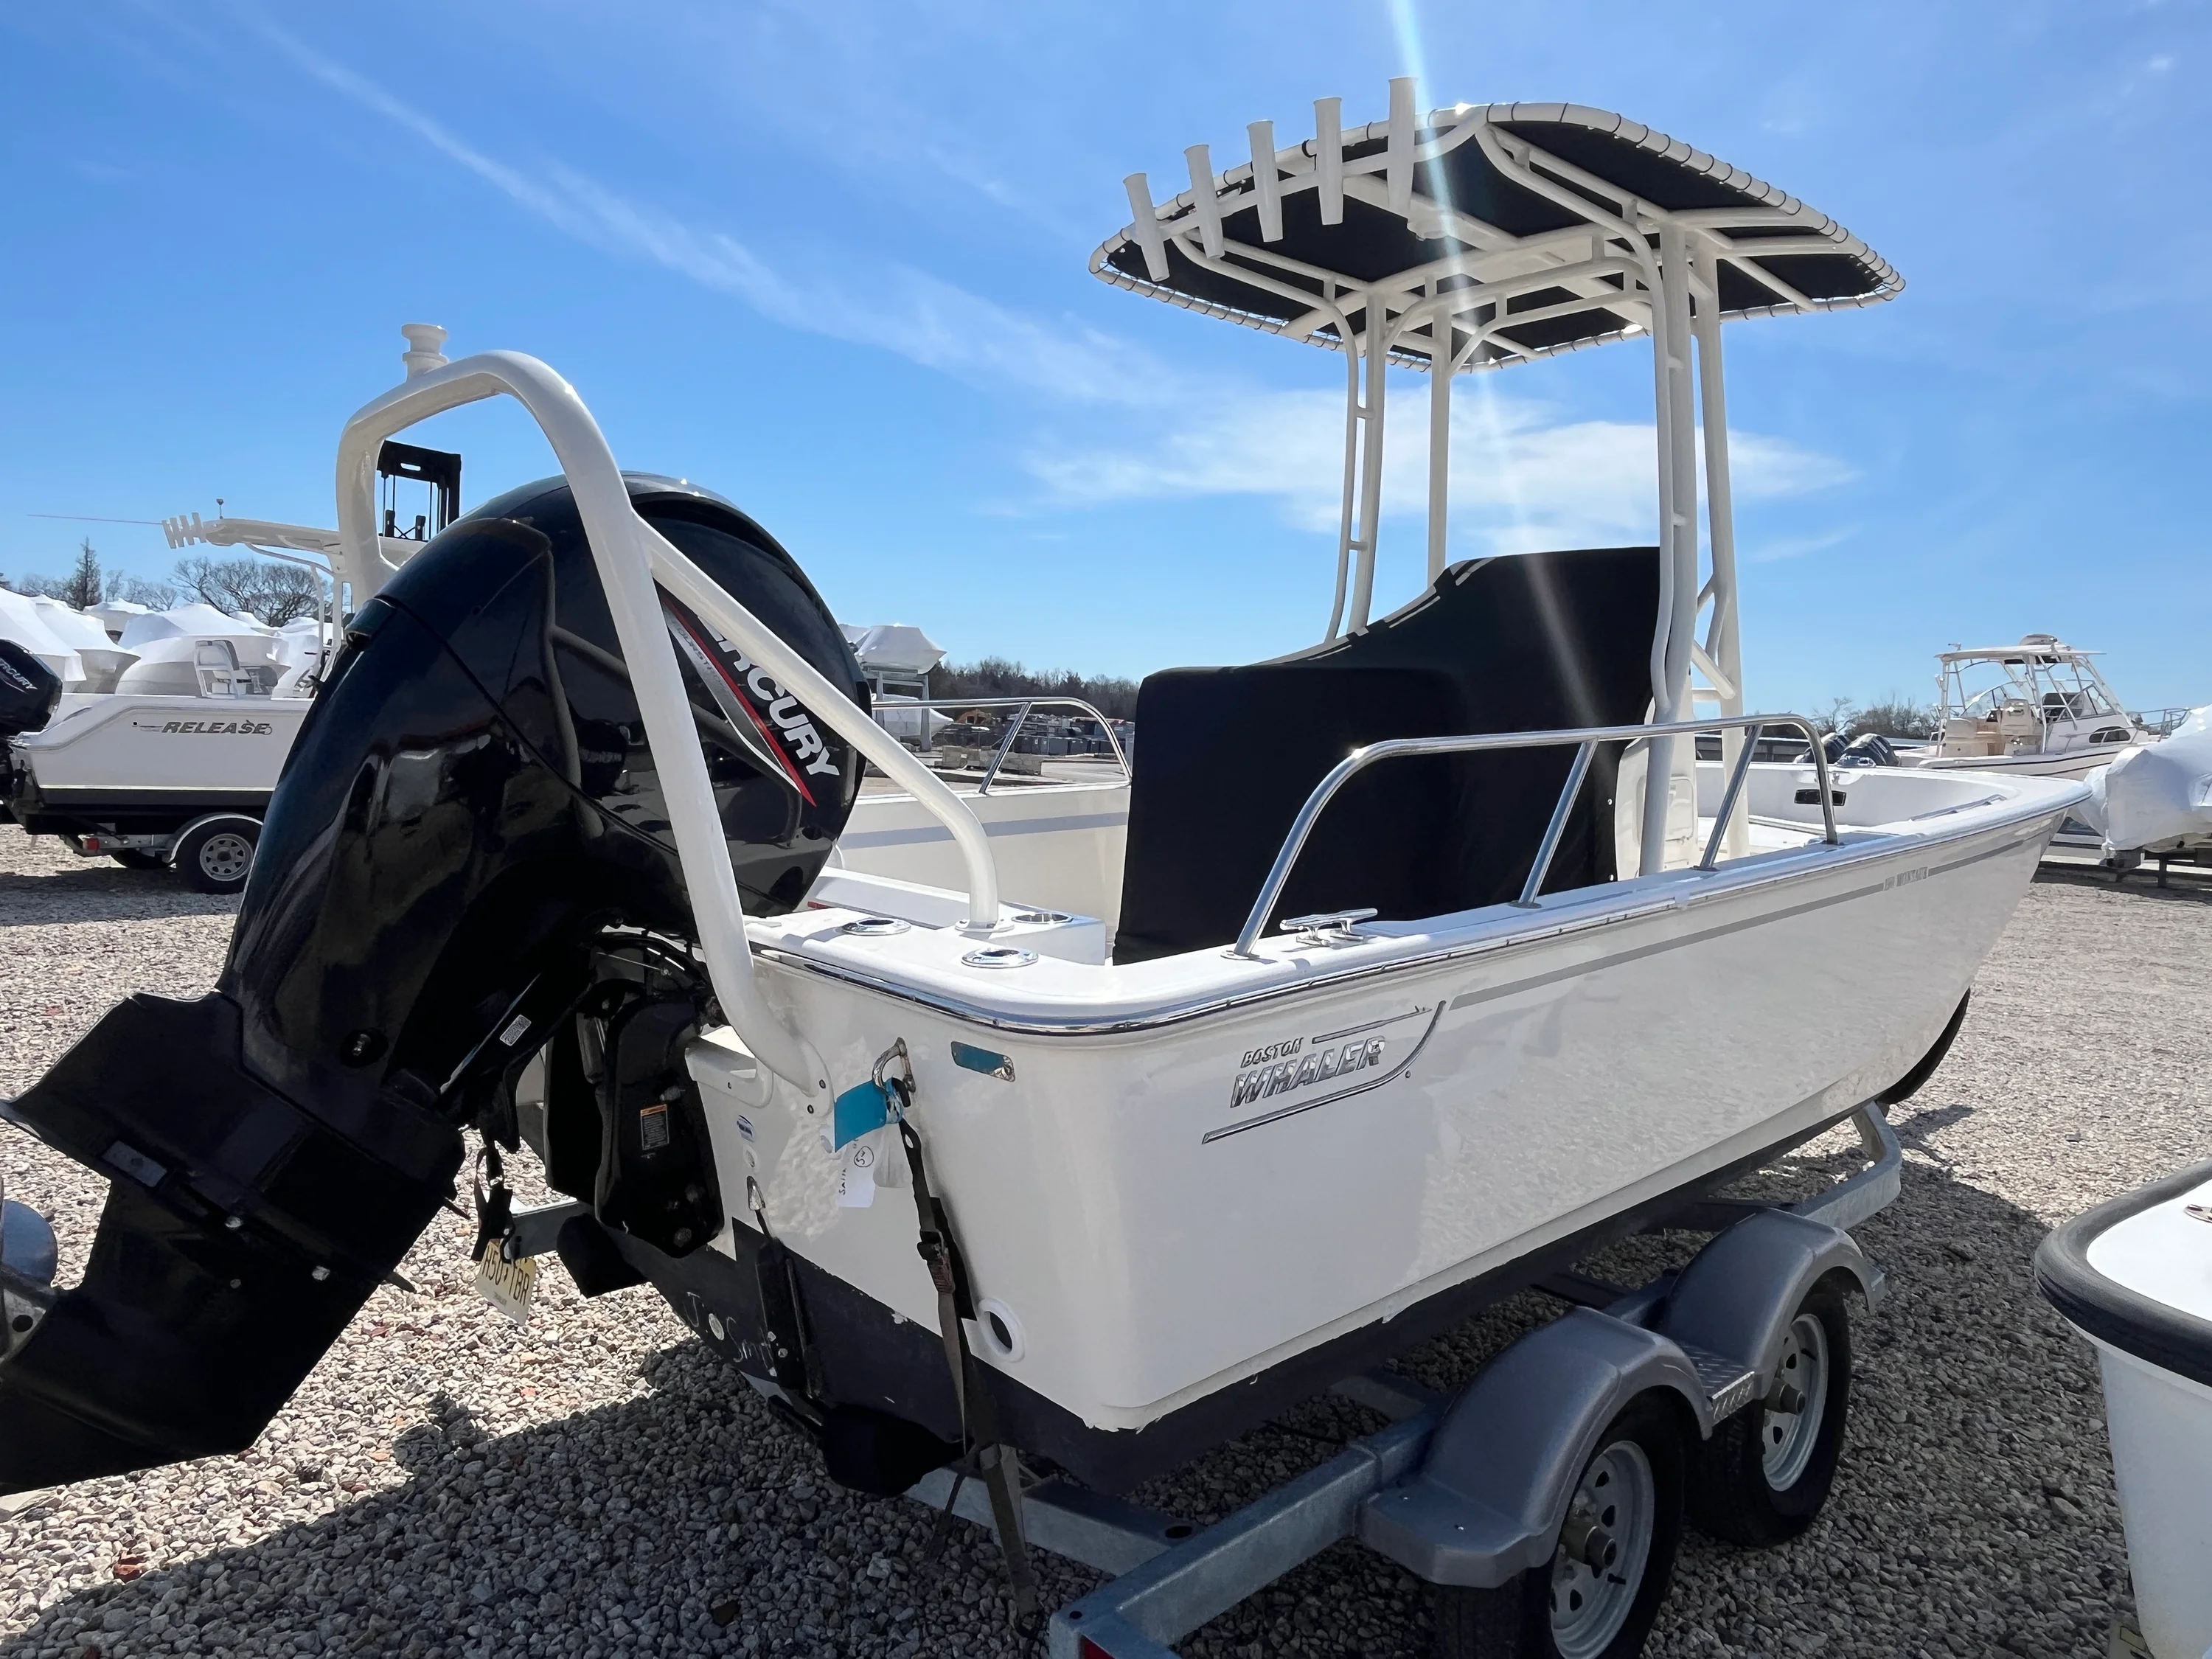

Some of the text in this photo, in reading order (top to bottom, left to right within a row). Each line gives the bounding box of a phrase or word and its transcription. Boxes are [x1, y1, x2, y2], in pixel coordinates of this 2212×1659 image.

[161, 720, 272, 735] RELEASE
[1239, 1037, 1304, 1068] BOSTON
[1230, 1035, 1386, 1108] WHALER
